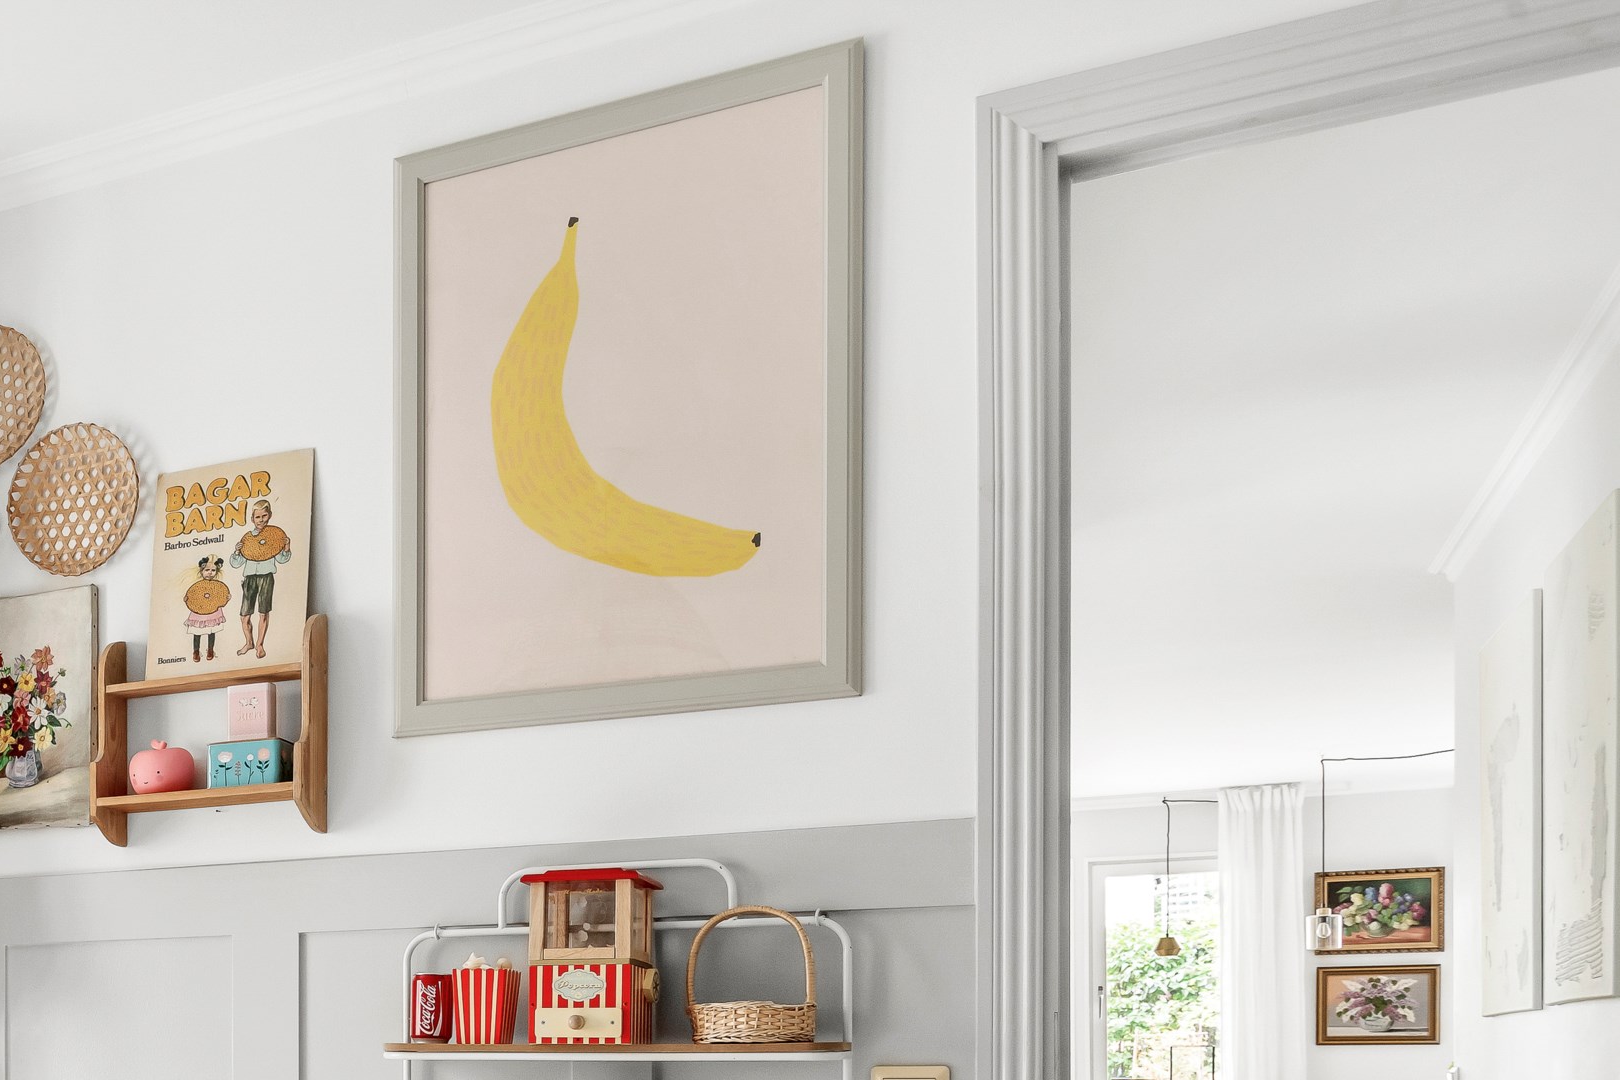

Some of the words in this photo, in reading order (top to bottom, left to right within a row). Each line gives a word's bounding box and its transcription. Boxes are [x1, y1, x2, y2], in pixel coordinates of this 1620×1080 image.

[165, 471, 272, 514] BAGAR
[164, 500, 248, 539] BARN
[164, 540, 192, 551] Barbro
[192, 534, 225, 547] Sedwall
[157, 655, 187, 665] Bonniers
[419, 984, 437, 1035] Coca-Cola
